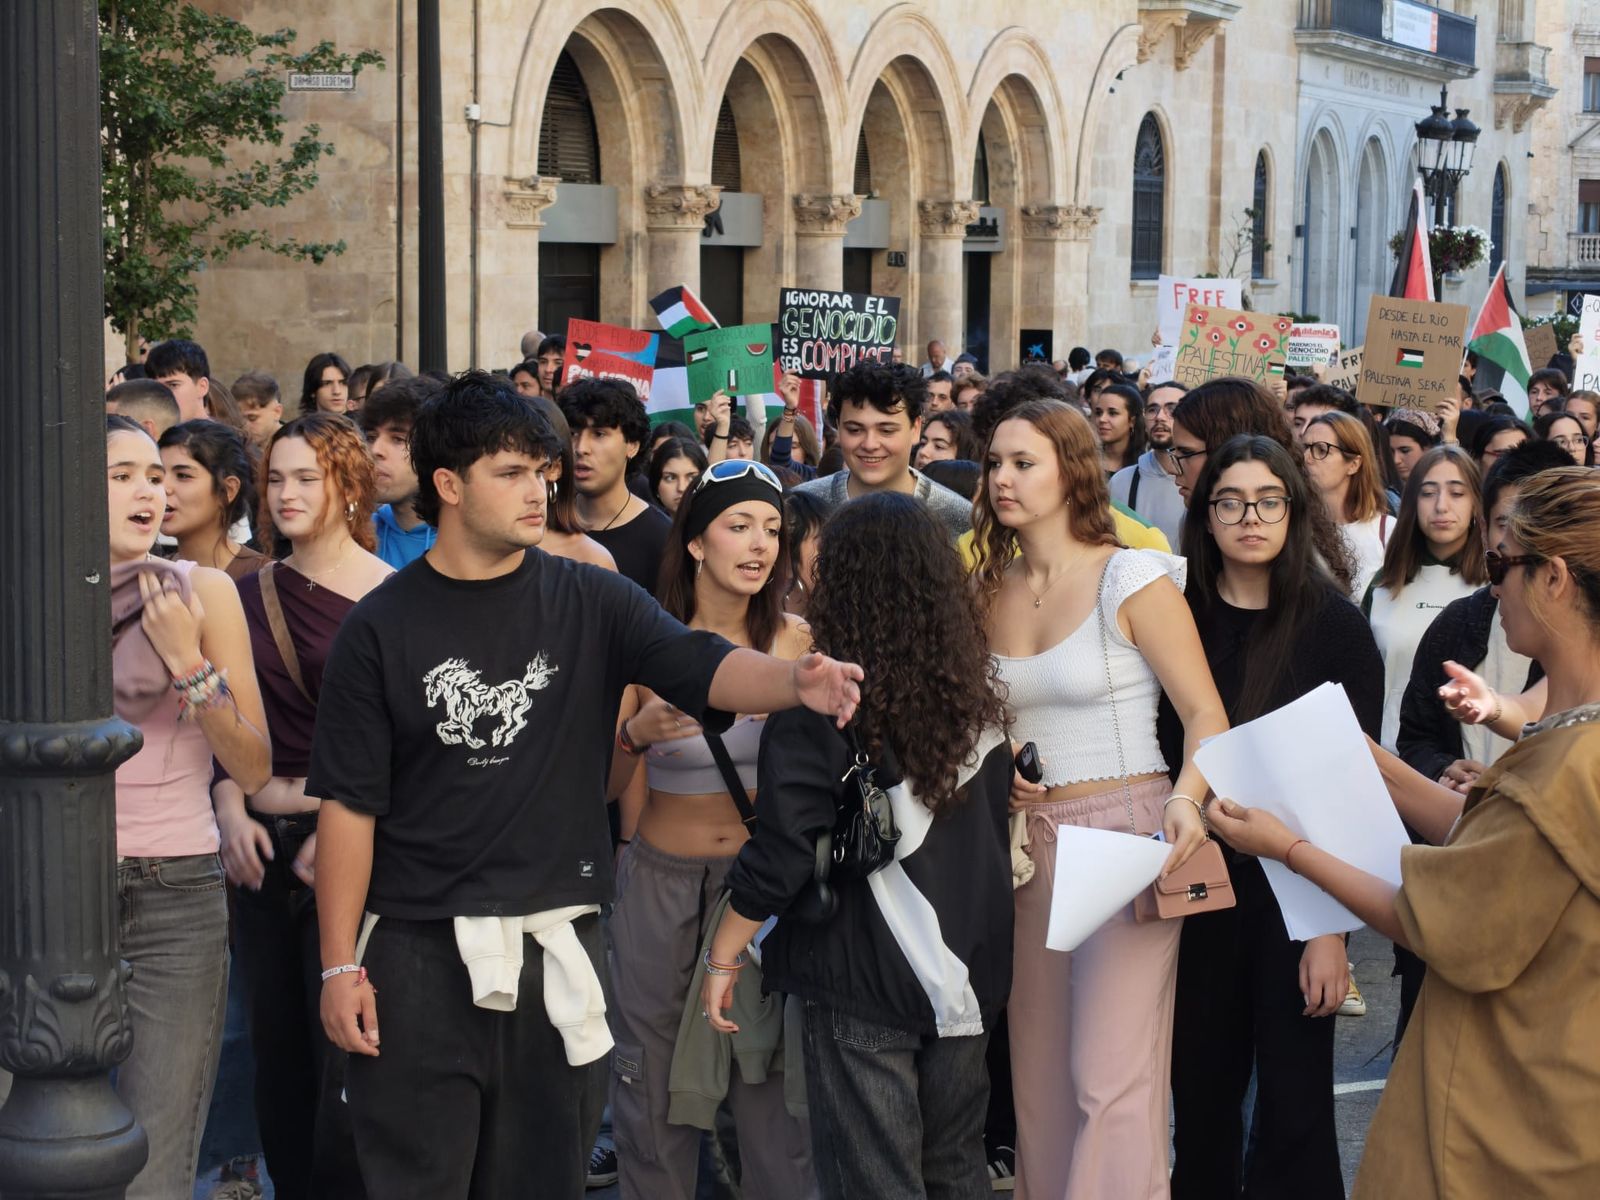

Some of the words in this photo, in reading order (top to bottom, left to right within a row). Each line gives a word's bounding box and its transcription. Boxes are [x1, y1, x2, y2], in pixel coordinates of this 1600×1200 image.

[785, 290, 853, 309] IGNORAR
[865, 296, 888, 315] EL
[1174, 283, 1226, 310] FREE
[782, 307, 897, 345] GENOCIDIO
[1379, 307, 1408, 322] DESDE
[1412, 312, 1426, 324] EL
[782, 338, 799, 354] ES
[1391, 328, 1419, 342] HASTA
[1422, 333, 1434, 344] EL
[1438, 335, 1460, 348] MAR
[780, 355, 803, 375] SER
[1183, 345, 1265, 377] PALESTINA
[1364, 369, 1412, 389] PALESTINA
[1418, 378, 1446, 392] SERÁ
[1382, 390, 1427, 408] LIBRE
